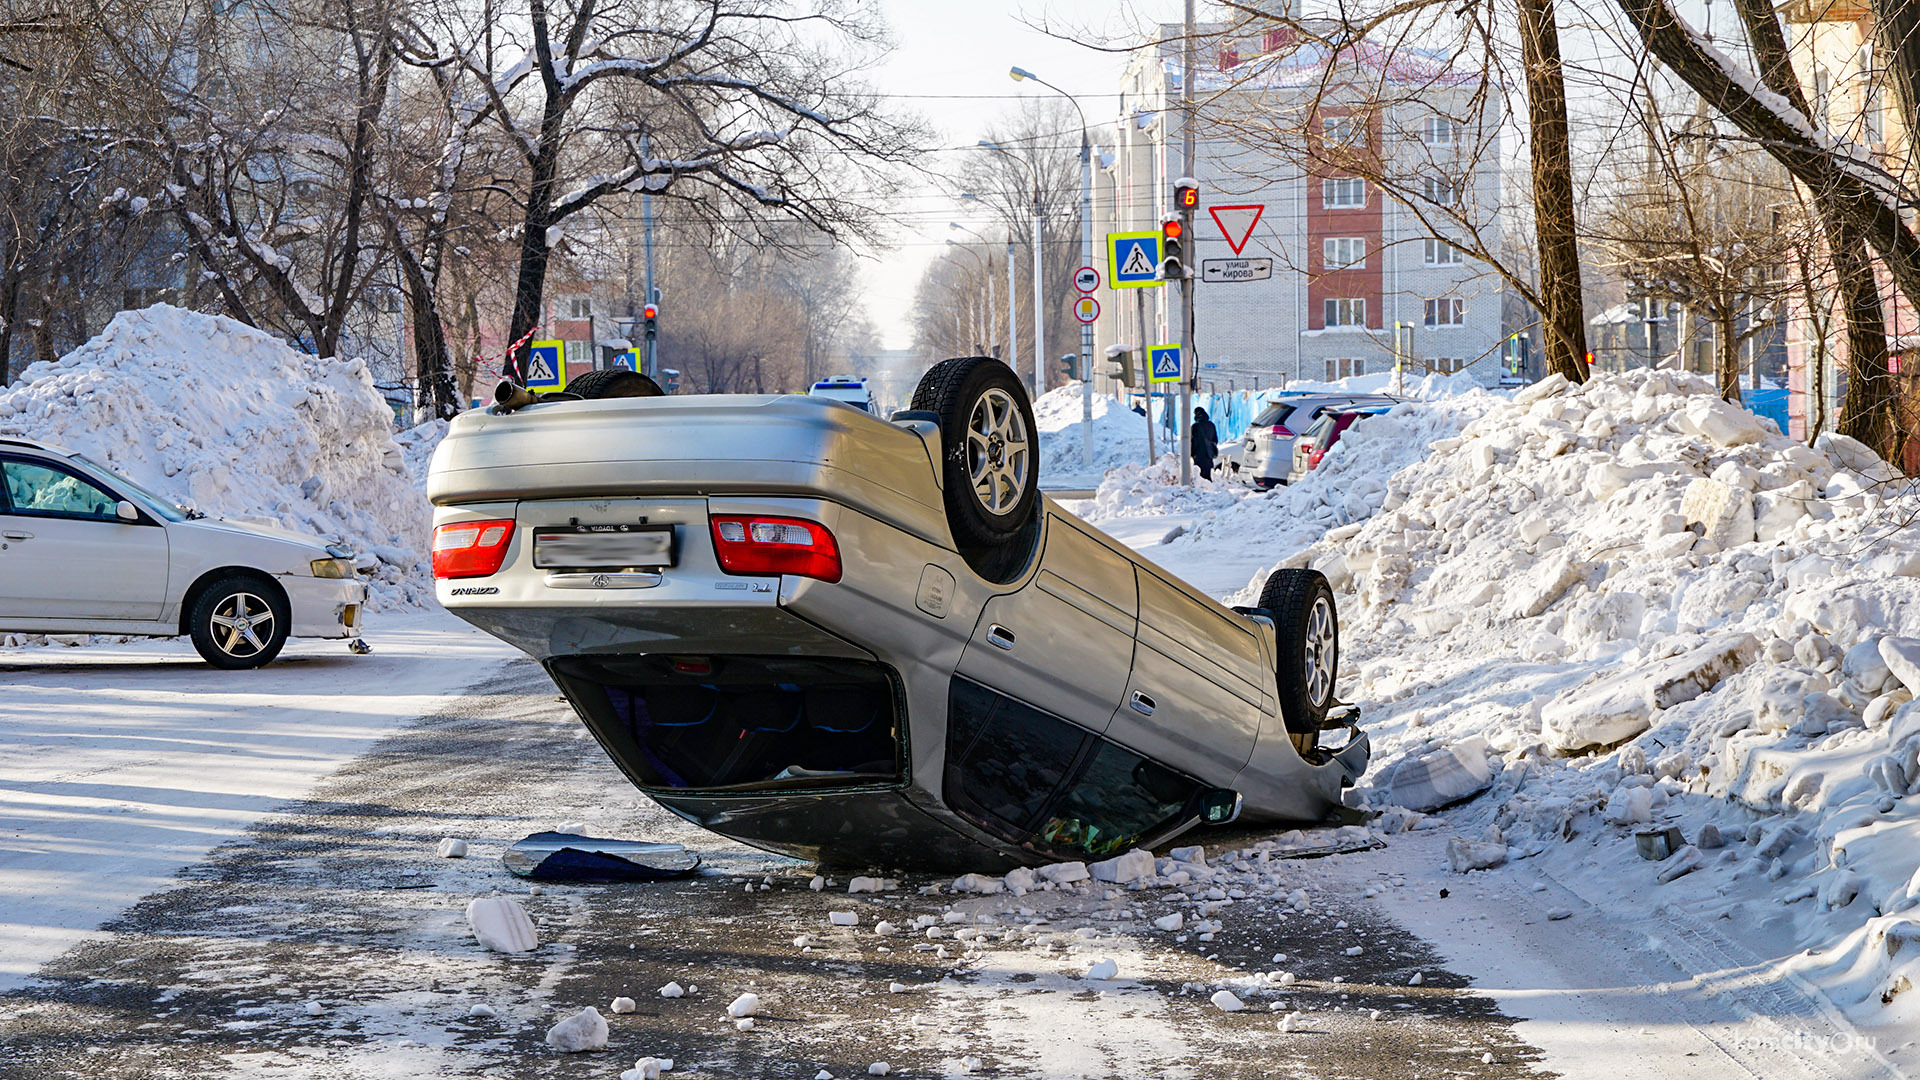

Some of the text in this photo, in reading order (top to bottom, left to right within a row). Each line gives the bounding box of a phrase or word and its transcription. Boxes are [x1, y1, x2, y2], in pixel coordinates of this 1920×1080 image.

[1185, 190, 1195, 205] 6
[1226, 261, 1249, 270] улица
[1223, 270, 1254, 279] кирова
[451, 587, 500, 596] CARINA
